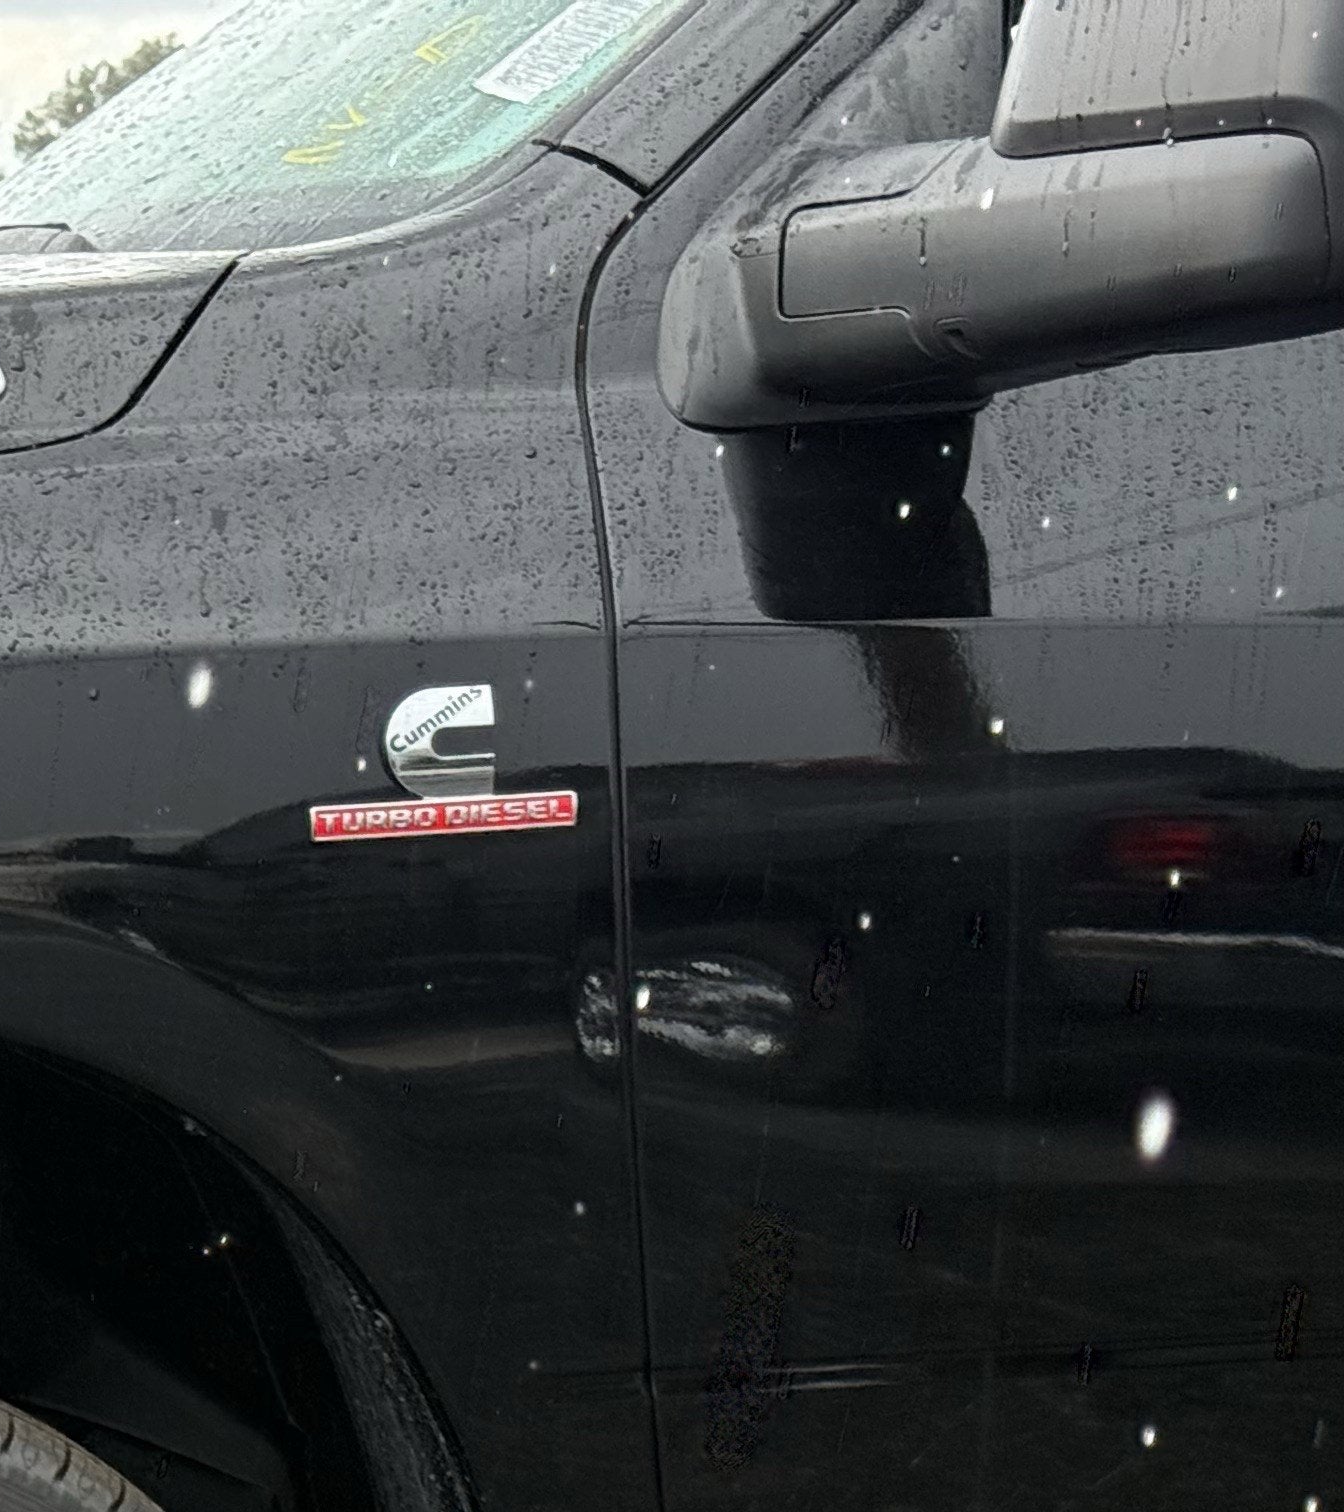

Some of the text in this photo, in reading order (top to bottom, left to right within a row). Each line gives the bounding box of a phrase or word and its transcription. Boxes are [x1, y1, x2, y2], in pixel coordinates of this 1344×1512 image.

[389, 685, 483, 753] Cummins
[317, 798, 571, 833] TURBO DIESEL
